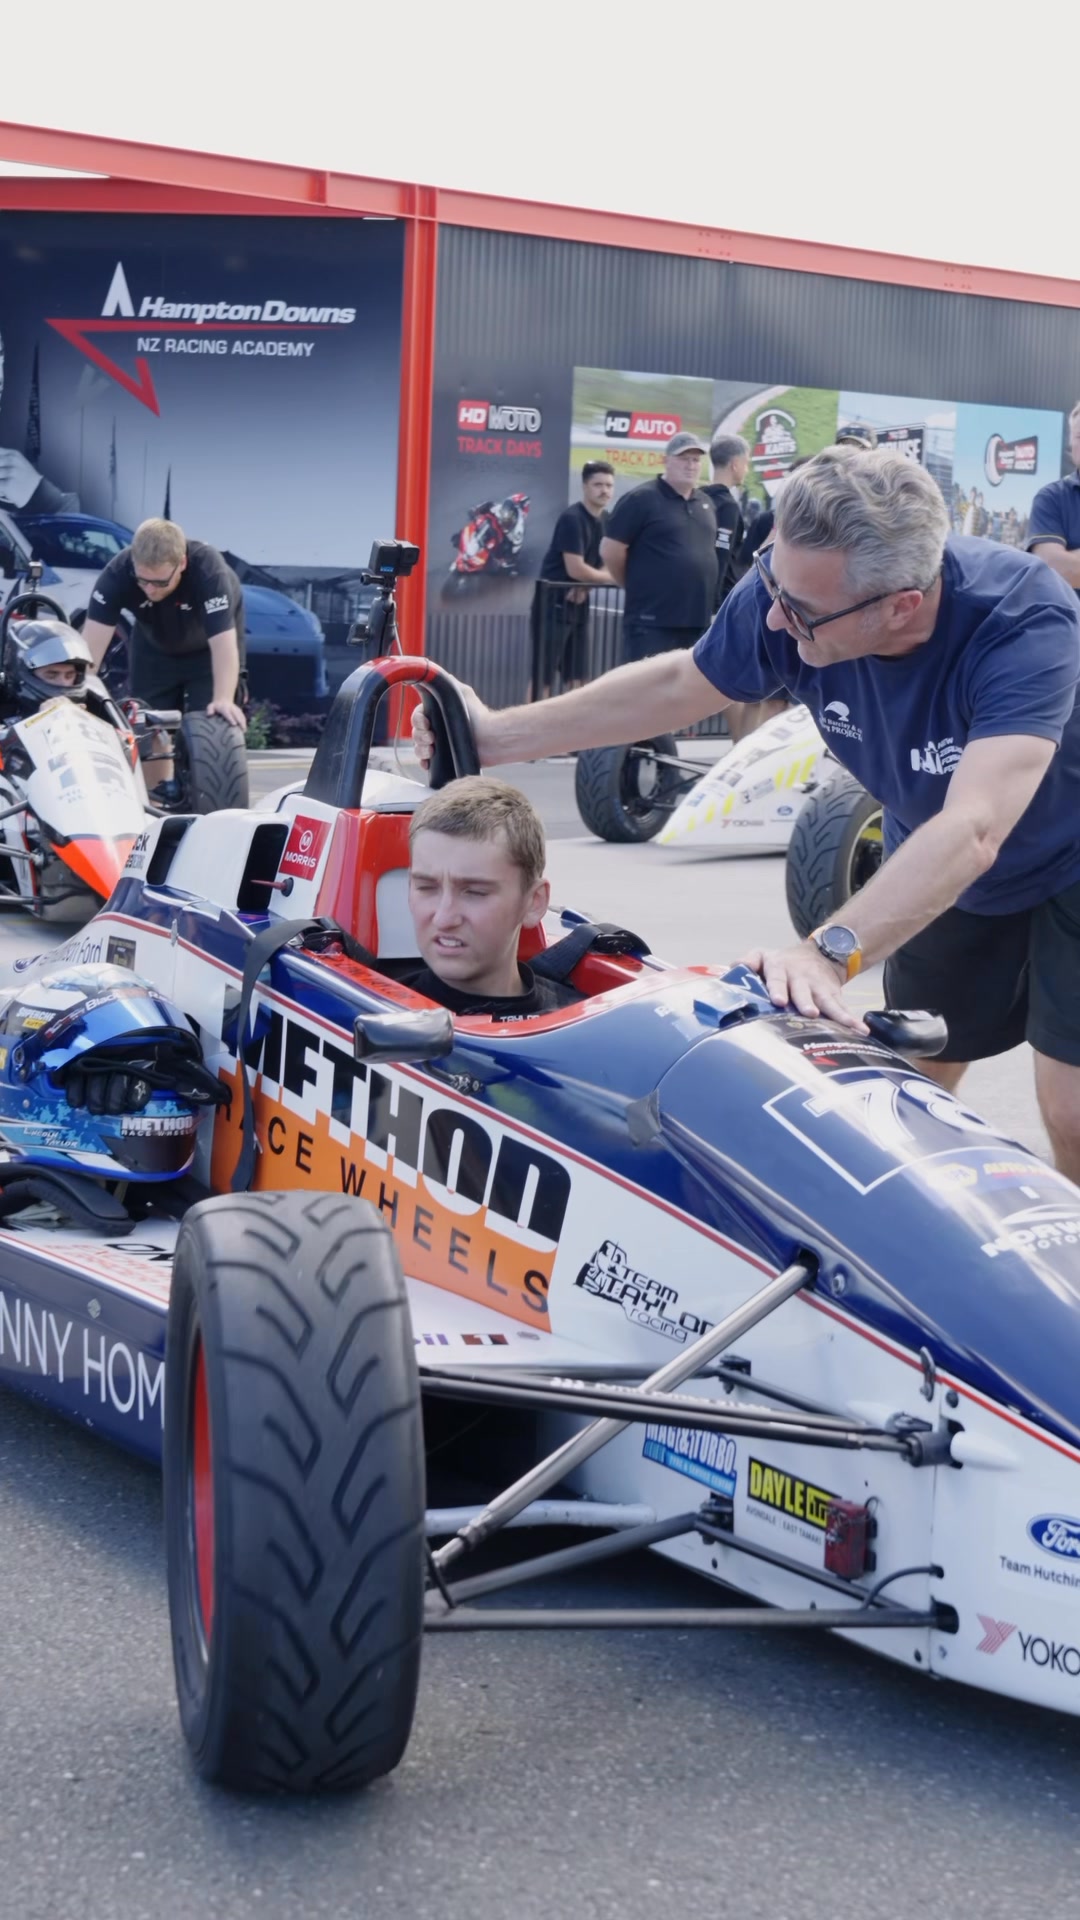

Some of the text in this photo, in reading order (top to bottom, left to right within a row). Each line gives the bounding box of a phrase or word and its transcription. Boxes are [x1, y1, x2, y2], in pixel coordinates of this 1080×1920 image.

[137, 338, 314, 357] NZ RACING ACADEMY
[460, 405, 541, 432] HD MOTO
[606, 417, 677, 436] HD AUTO
[457, 436, 543, 458] TRACK DAYS
[605, 449, 644, 466] TRACK
[284, 851, 316, 869] MORRIS
[121, 1115, 193, 1131] METHOD
[121, 1130, 152, 1138] RACE
[340, 1156, 549, 1314] WHEELS
[621, 1265, 679, 1304] TEAM
[630, 1308, 688, 1344] racing
[750, 1460, 804, 1518] DAYLE
[783, 1520, 798, 1534] EAST
[999, 1555, 1031, 1576] Team
[1018, 1631, 1080, 1676] YOKO
